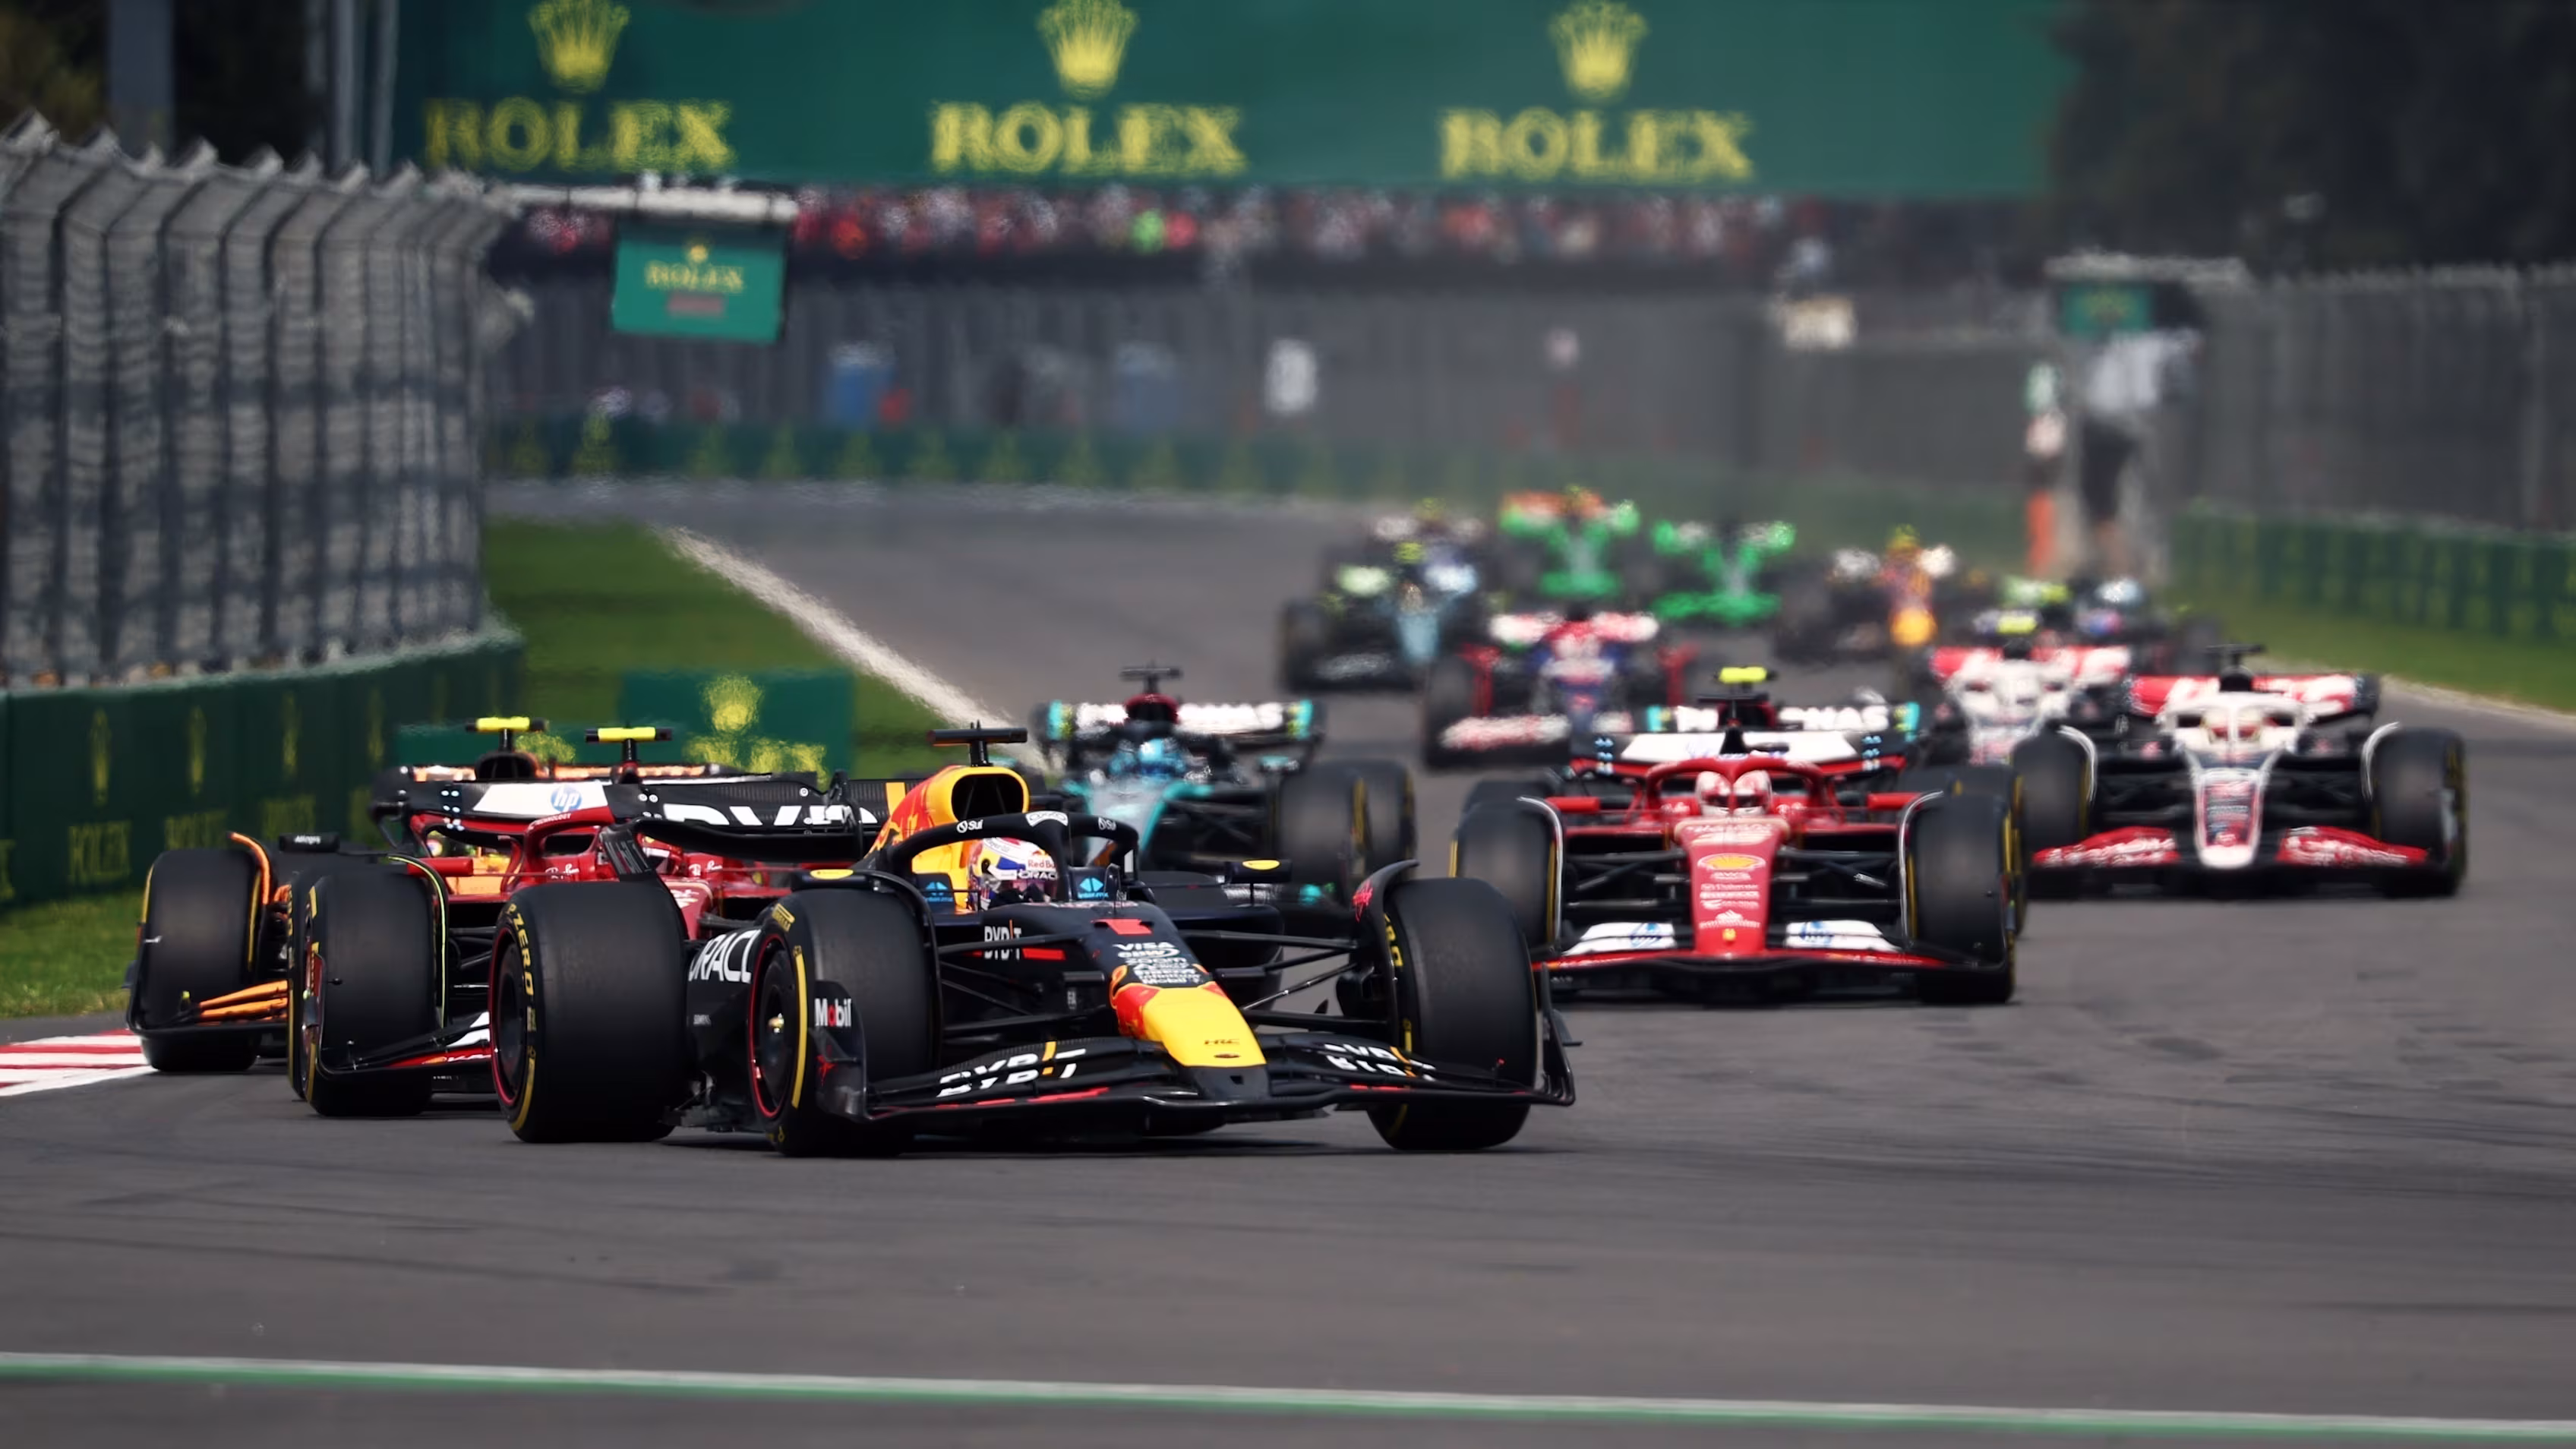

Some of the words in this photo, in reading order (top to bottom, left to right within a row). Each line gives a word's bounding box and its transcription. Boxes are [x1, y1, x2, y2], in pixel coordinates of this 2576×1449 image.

[425, 97, 738, 172] ROLEX
[931, 100, 1247, 175] ROLEX
[1440, 105, 1754, 181] ROLEX
[513, 913, 535, 996] ZERO
[1112, 942, 1176, 951] VISA
[815, 998, 852, 1028] Mobil
